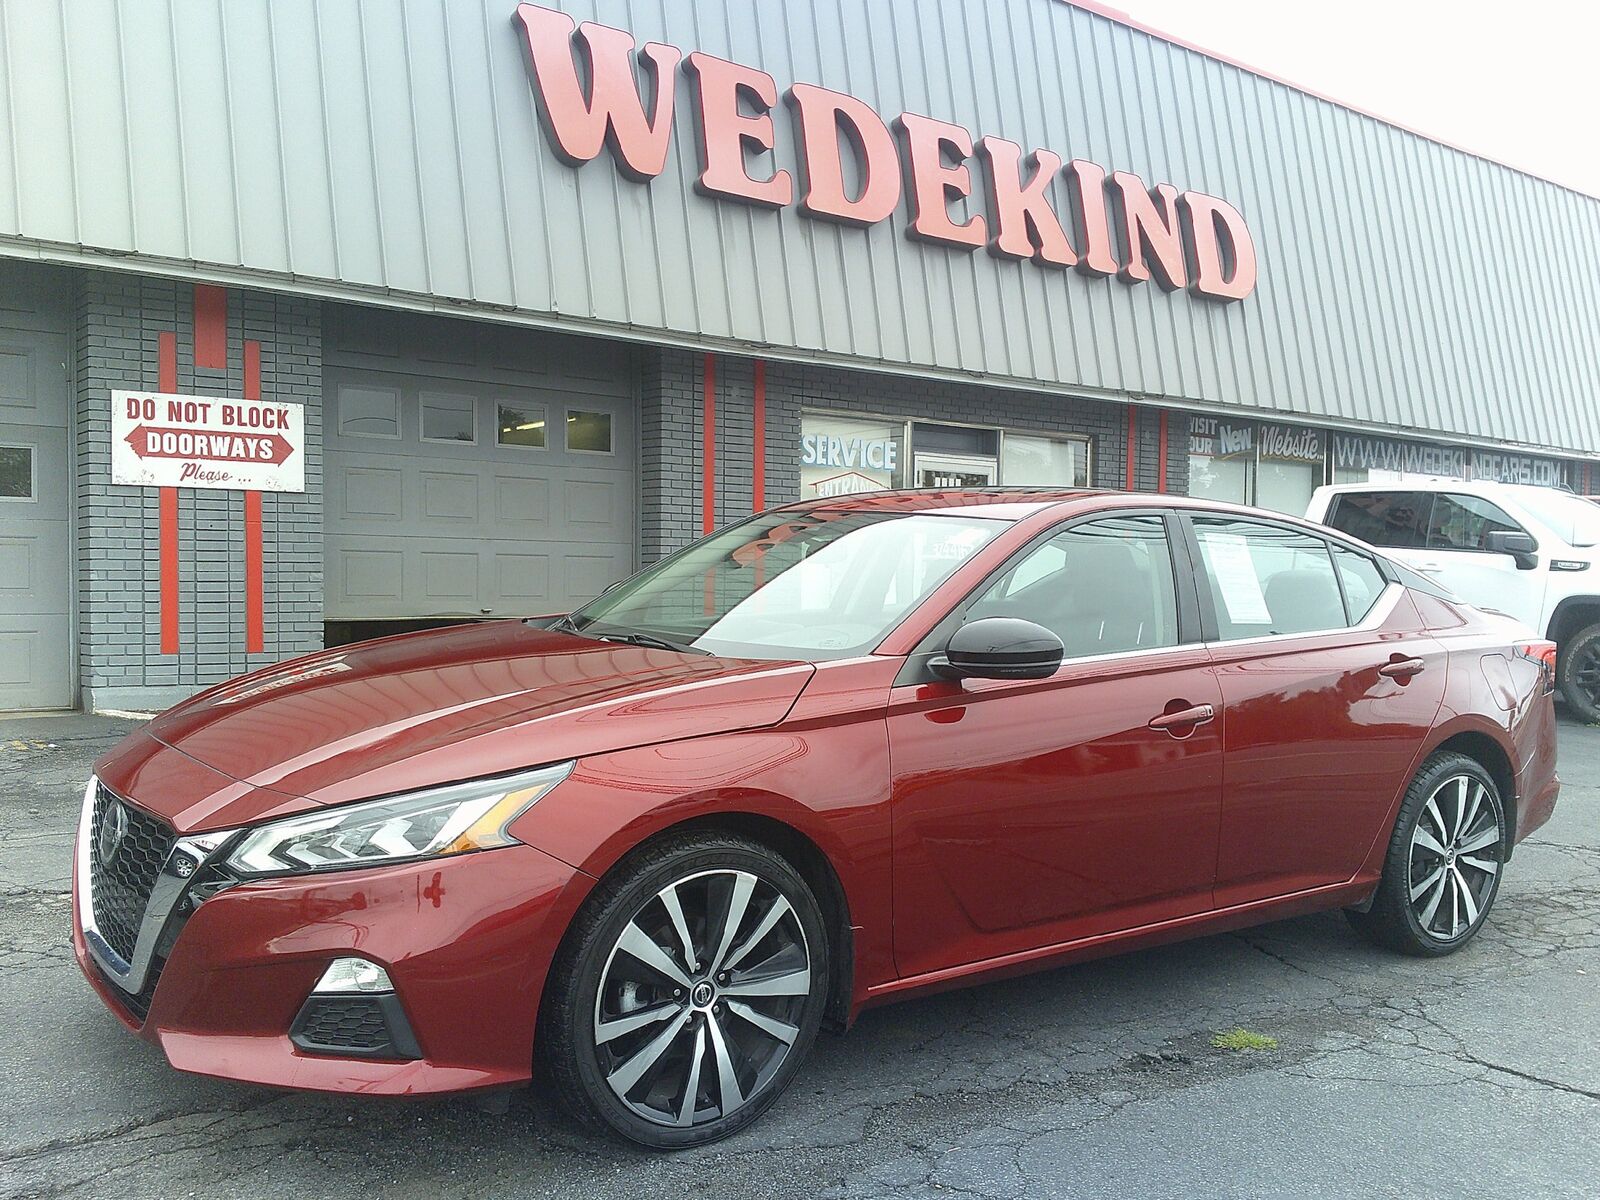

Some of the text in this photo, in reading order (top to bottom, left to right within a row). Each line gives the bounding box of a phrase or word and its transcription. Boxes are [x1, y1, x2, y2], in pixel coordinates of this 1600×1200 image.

[512, 3, 1257, 302] WEDEKIND
[127, 398, 290, 430] DO NOT BLOCK
[146, 432, 273, 460] DOORWAYS
[801, 434, 897, 472] SERVICE
[180, 462, 233, 482] Please
